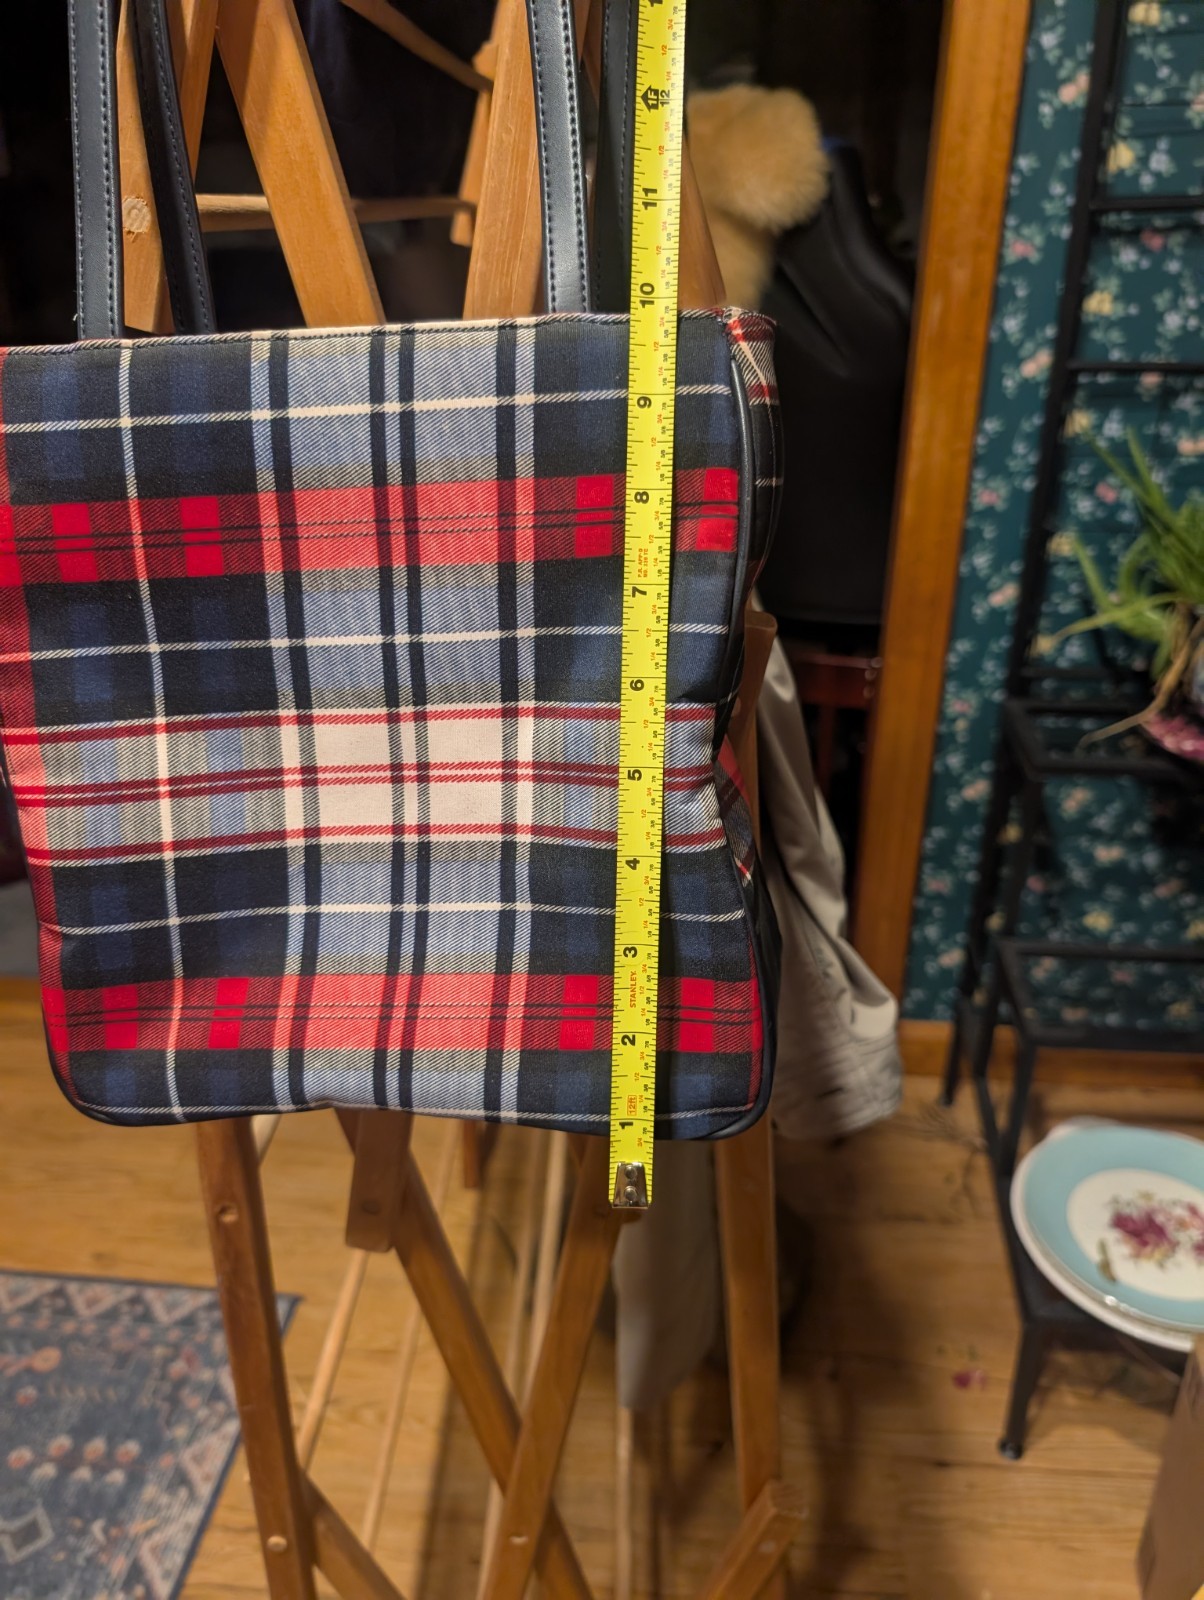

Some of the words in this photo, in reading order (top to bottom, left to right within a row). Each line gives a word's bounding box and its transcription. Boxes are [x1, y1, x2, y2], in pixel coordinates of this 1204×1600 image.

[648, 90, 658, 106] 1F
[660, 90, 670, 108] 12
[642, 188, 658, 210] 11
[639, 282, 655, 308] 10
[637, 396, 652, 409] 9
[634, 491, 650, 504] 8
[632, 586, 647, 598] 7
[630, 679, 644, 691] 6
[628, 769, 642, 781] 5
[625, 858, 640, 870] 4
[623, 946, 638, 958] 3
[621, 1034, 635, 1046] 2
